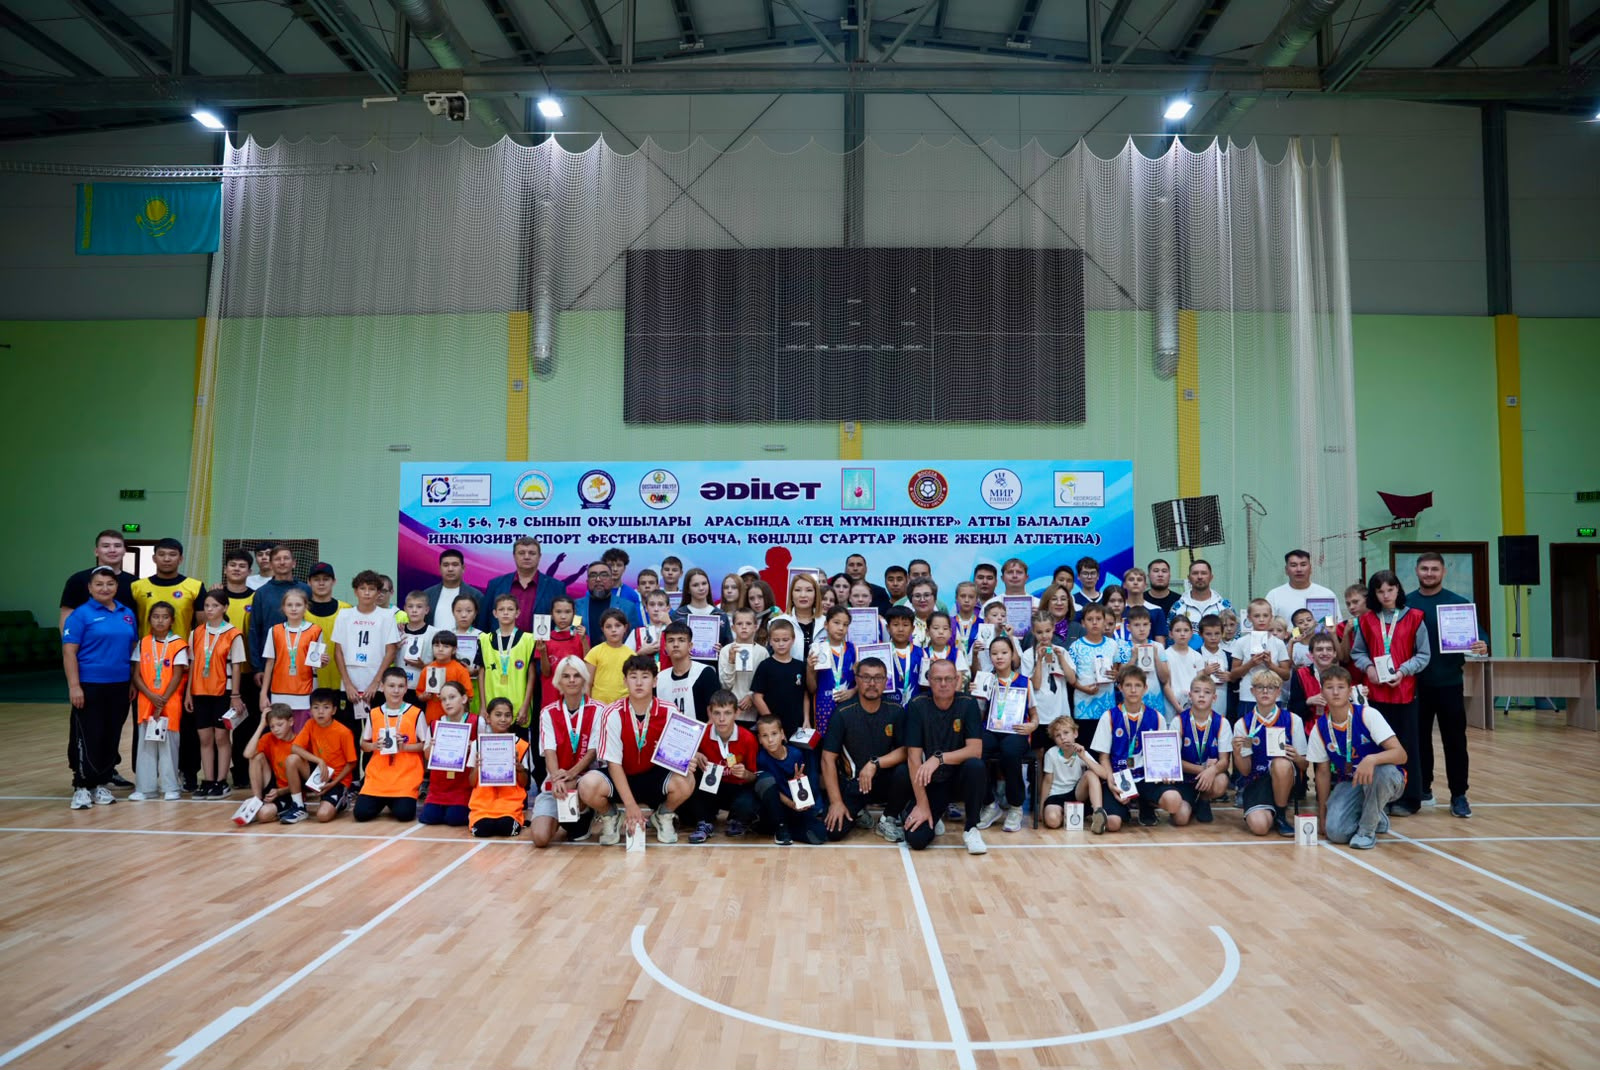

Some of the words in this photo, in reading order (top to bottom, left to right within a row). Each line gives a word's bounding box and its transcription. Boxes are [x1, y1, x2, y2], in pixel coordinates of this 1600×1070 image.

[990, 489, 1014, 497] МИР
[439, 517, 463, 529] 3-4,
[468, 517, 492, 529] 5-6,
[497, 517, 518, 528] 7-8
[524, 516, 581, 527] СЫНЫП
[587, 516, 691, 528] ОҚУШЫЛАРЫ
[704, 516, 791, 528] АРАСЫНДА
[968, 516, 1011, 527] АТТЫ
[1017, 516, 1090, 527] БАЛАЛАР
[534, 533, 582, 544] СПОРТ
[587, 533, 674, 545] ФЕСТИВАЛІ
[682, 533, 742, 546] (БОЧЧА,
[819, 533, 896, 545] СТАРТТАР
[902, 533, 948, 545] ЖӘНЕ
[955, 533, 1007, 546] ЖЕҢІЛ
[1014, 533, 1102, 546] АТЛЕТИКА)
[358, 630, 369, 648] 14
